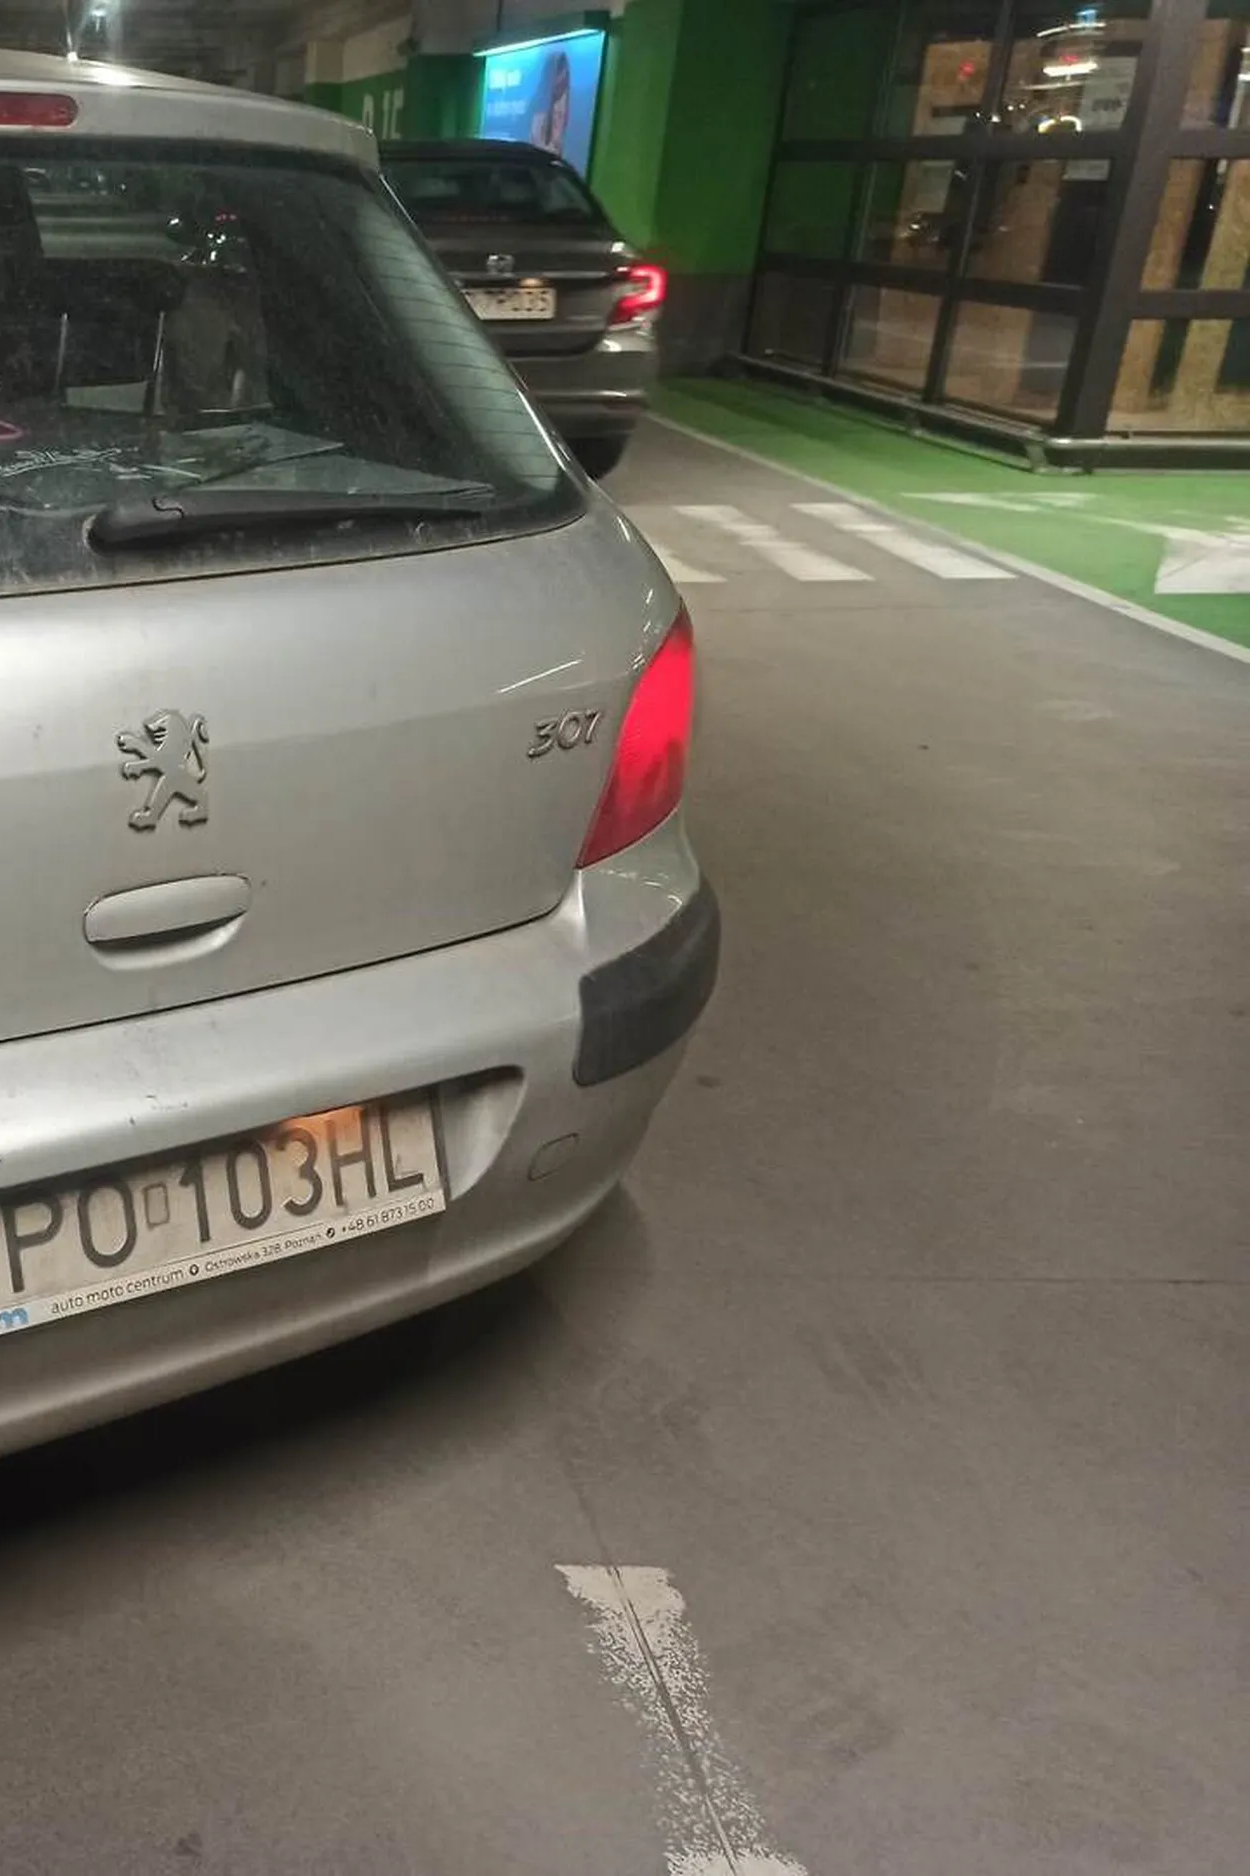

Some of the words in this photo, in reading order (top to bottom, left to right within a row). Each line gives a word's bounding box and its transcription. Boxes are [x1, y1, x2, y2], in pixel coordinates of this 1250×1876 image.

[527, 709, 601, 759] 307
[51, 1295, 84, 1315] auto
[86, 1285, 124, 1305] moto
[126, 1268, 184, 1293] centrum
